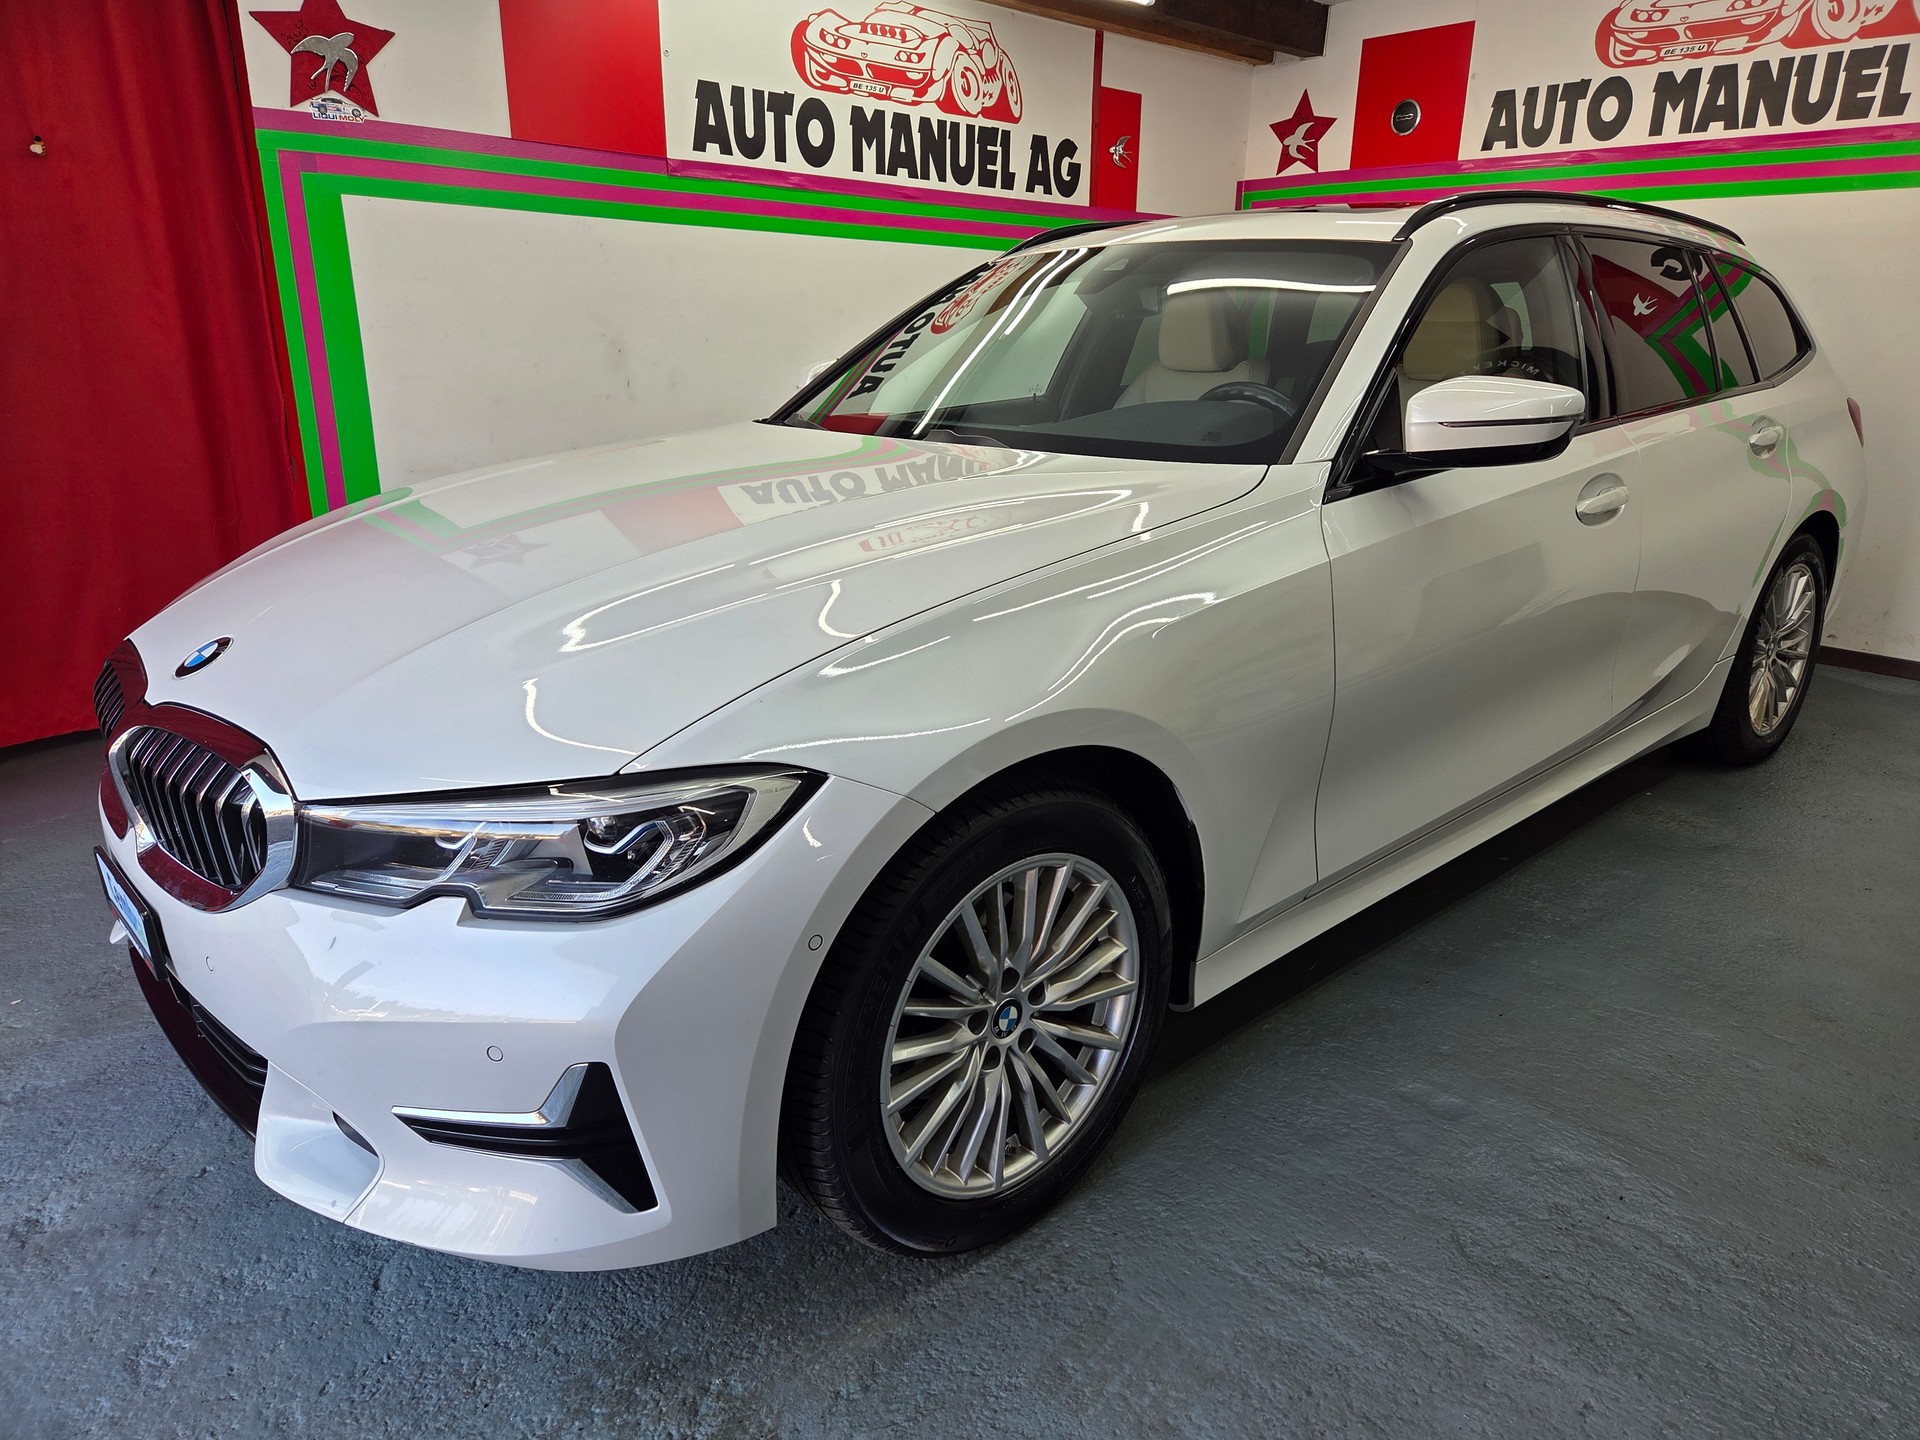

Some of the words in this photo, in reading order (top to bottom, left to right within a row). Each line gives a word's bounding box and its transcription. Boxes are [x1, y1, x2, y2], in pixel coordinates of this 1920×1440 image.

[853, 82, 863, 90] BE
[1481, 76, 1633, 151] AUTO
[1648, 43, 1912, 137] MANUEL
[313, 112, 337, 120] LIQUI
[692, 79, 835, 168] AUTO
[849, 105, 1016, 190] MANUEL
[1026, 134, 1082, 199] AG
